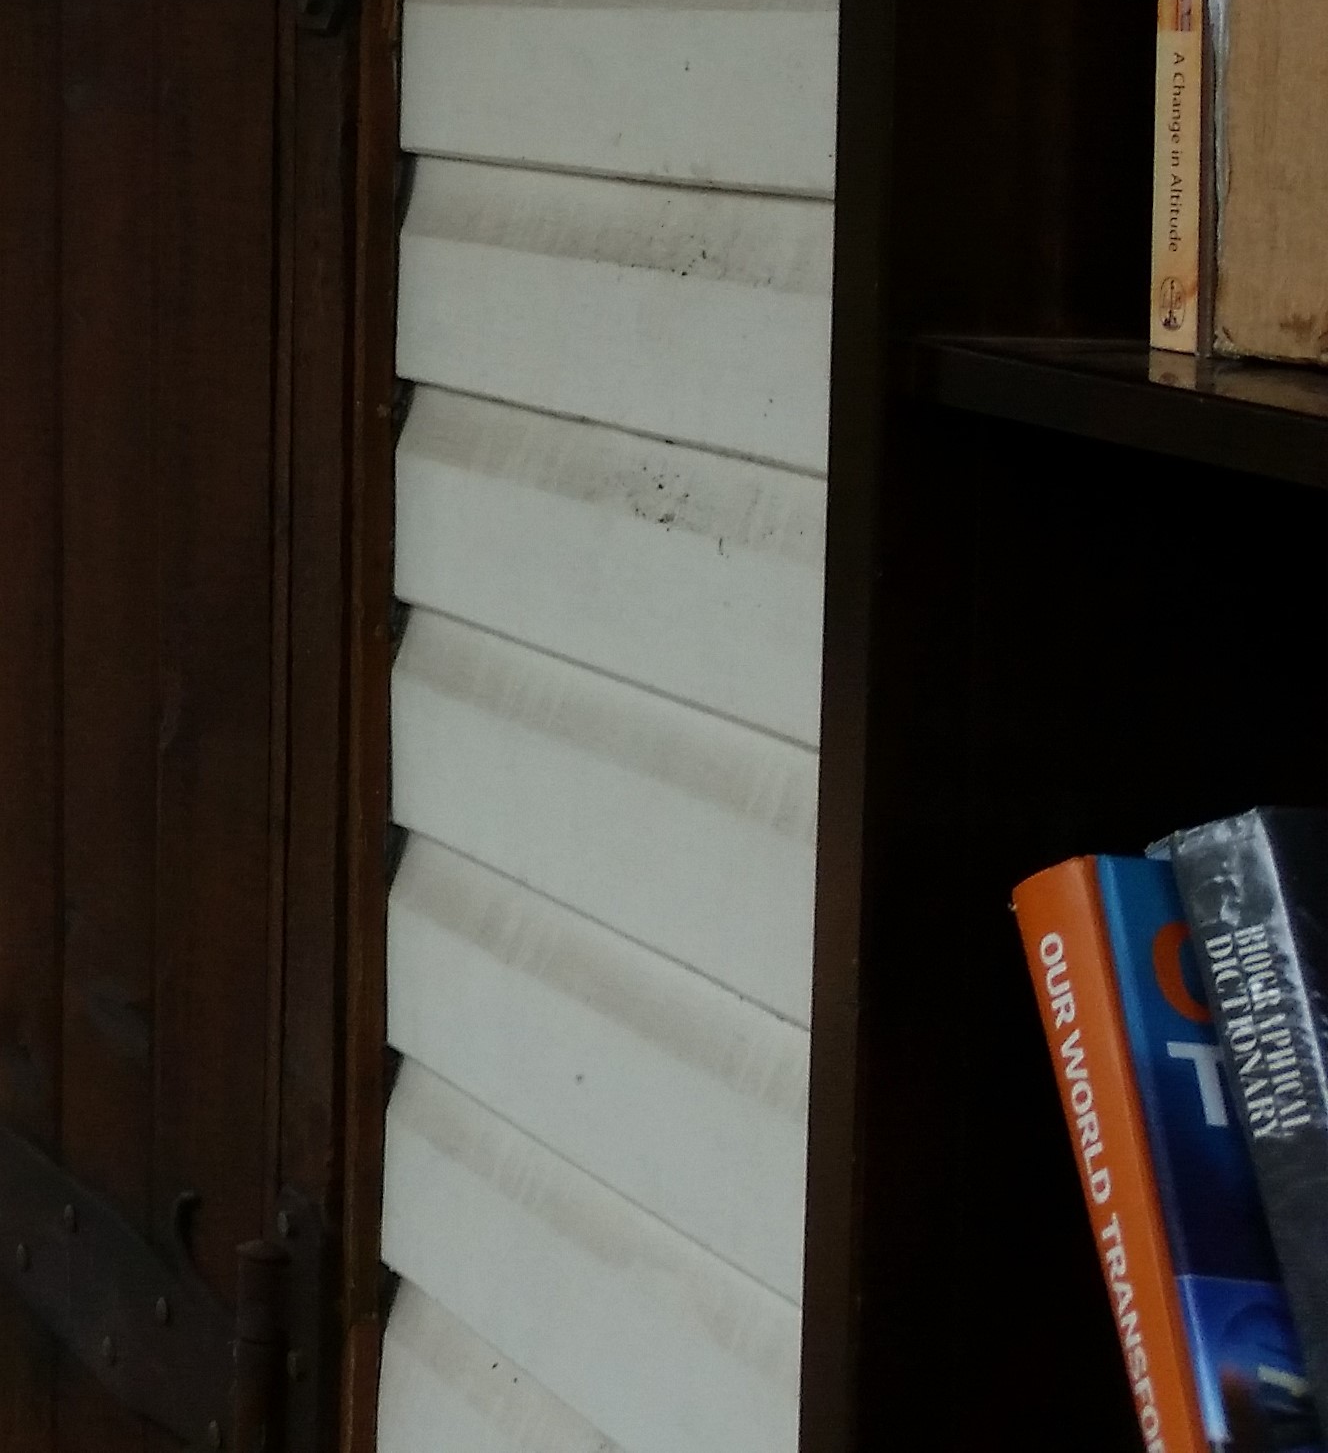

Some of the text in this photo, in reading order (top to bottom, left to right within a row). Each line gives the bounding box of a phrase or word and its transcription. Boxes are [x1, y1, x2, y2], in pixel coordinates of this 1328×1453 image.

[1168, 51, 1186, 253] A Change in Altitude
[1039, 930, 1077, 1030] OUR
[1060, 1029, 1112, 1205] WORLD
[1205, 933, 1280, 1138] DICTIONARY
[1234, 923, 1311, 1130] BIOGRAPHICAL
